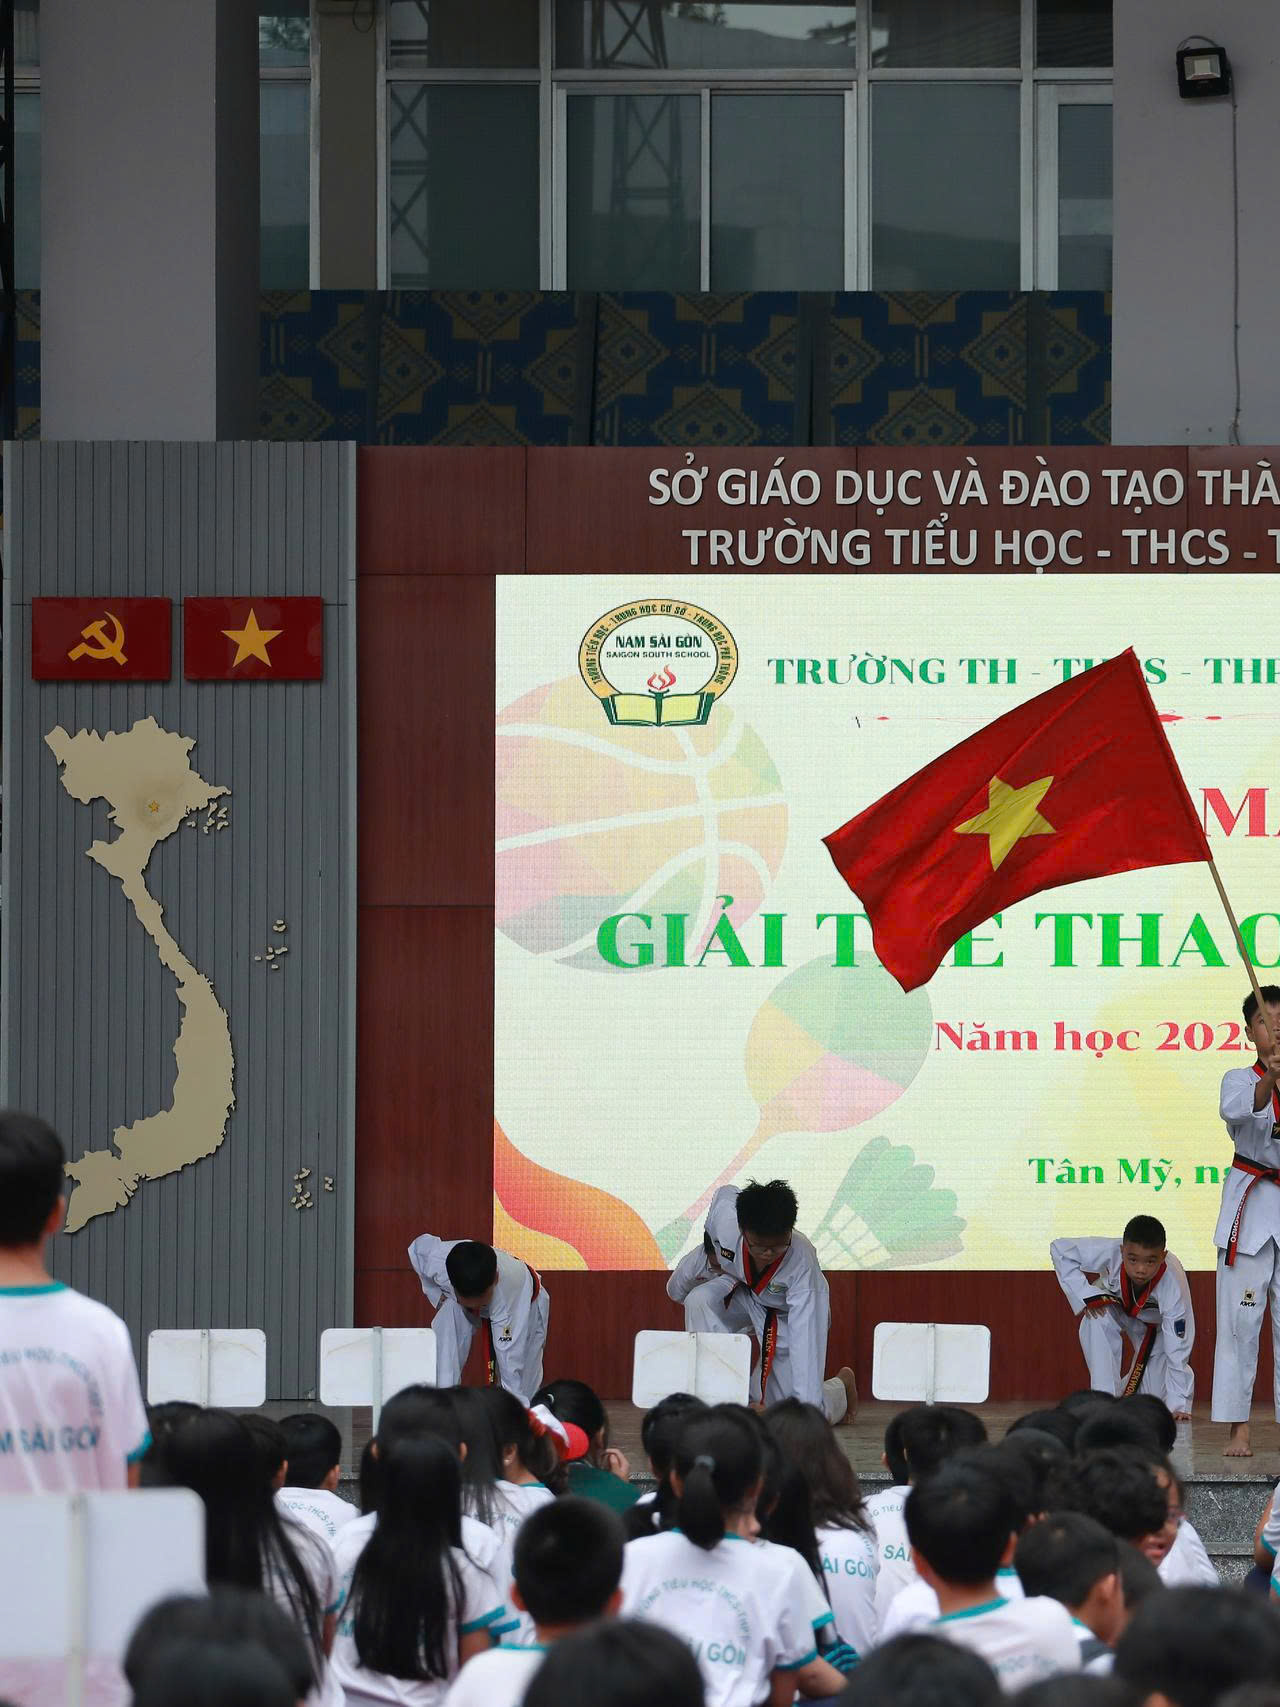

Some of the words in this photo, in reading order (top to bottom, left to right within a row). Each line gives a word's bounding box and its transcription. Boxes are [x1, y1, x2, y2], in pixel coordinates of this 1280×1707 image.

[648, 453, 708, 506] SỞ
[717, 457, 822, 506] GIÁO
[836, 469, 922, 515] DỤC
[933, 456, 988, 506] VÀ
[1000, 456, 1091, 507] ĐÀO
[1102, 468, 1184, 514] TẠO
[682, 518, 872, 567] TRƯỜNG
[885, 513, 978, 566] TIỂU
[995, 529, 1083, 575] HỌC
[1122, 528, 1230, 566] THCS
[615, 635, 646, 649] NAM
[767, 653, 945, 686] TRƯỜNG
[959, 657, 1018, 685] TH
[1053, 657, 1167, 685] TS
[596, 895, 787, 969] GIẢI
[935, 1022, 1039, 1052] Năm
[1054, 1021, 1141, 1058] học
[1028, 1158, 1104, 1184] Tân
[1117, 1158, 1182, 1191] Mỹ,
